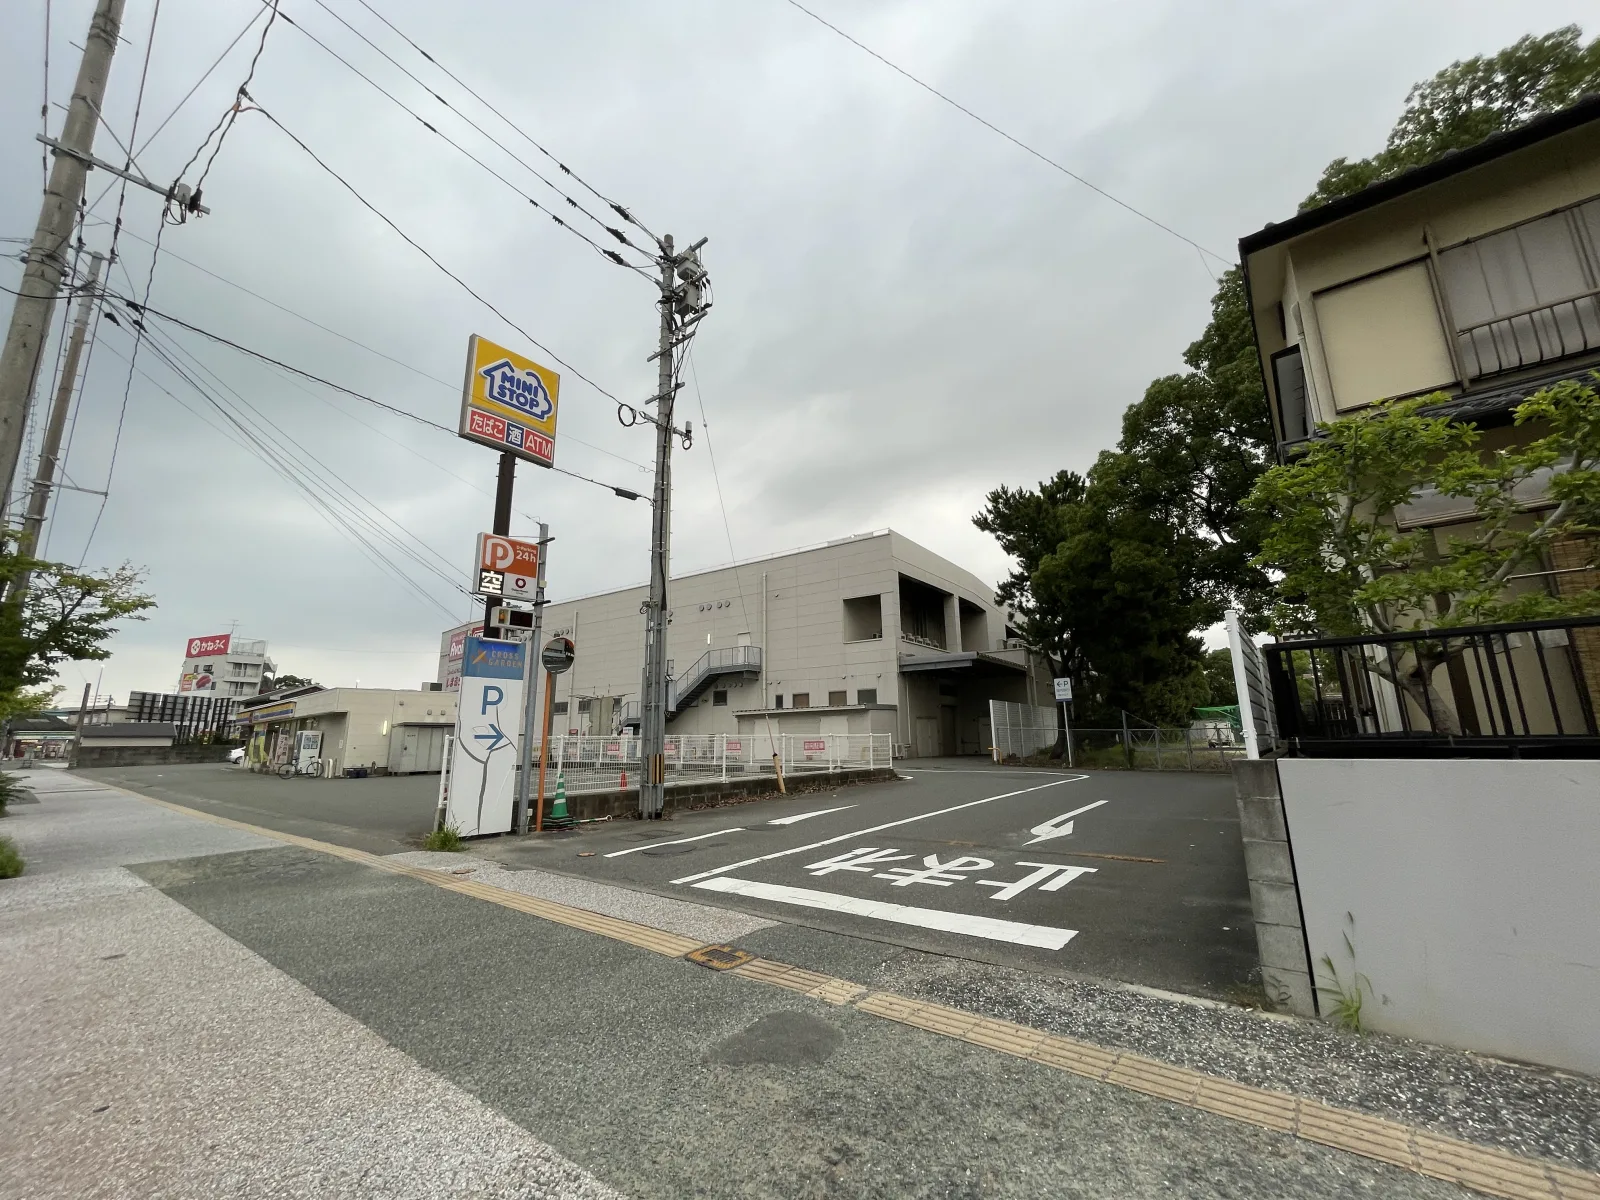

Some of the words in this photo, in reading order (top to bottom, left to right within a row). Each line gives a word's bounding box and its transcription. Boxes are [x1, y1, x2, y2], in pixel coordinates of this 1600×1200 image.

[501, 371, 539, 398] MINI
[497, 385, 540, 410] STOP
[471, 414, 503, 438] たばこ
[508, 426, 522, 443] 酒
[526, 435, 552, 458] ATM
[485, 538, 514, 569] P
[516, 550, 536, 563] 24h
[480, 571, 503, 594] 空
[200, 639, 226, 652] かねふく
[491, 650, 519, 661] CROSS
[488, 658, 523, 669] GARDEN
[481, 685, 503, 715] P
[803, 847, 1099, 902] 止まれ
